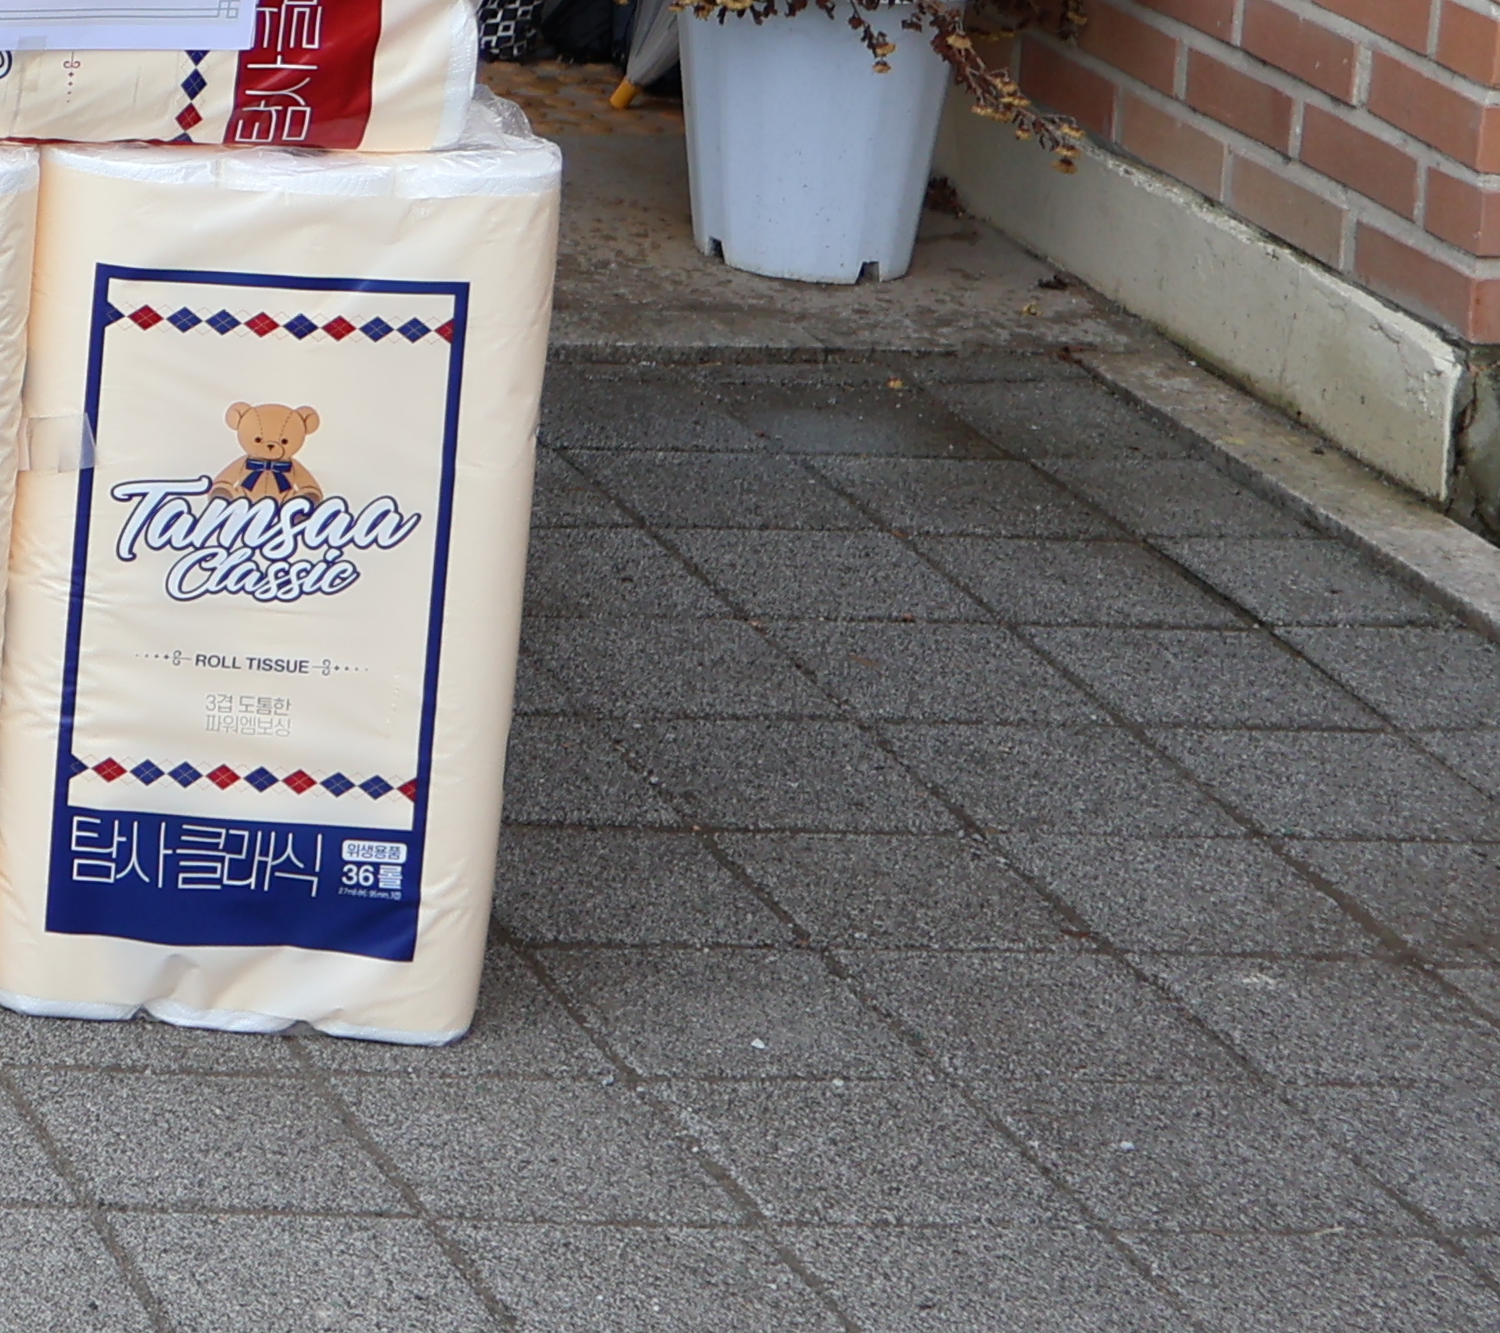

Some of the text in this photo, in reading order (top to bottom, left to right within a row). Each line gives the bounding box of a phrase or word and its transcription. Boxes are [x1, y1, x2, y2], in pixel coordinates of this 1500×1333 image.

[111, 476, 421, 562] Tamsaa
[166, 545, 361, 603] Classic
[195, 654, 310, 674] ROLL TISSUE
[205, 693, 292, 716] 3겹 도톰한
[205, 715, 292, 736] 파워엠보싱
[347, 844, 402, 861] 위생용품
